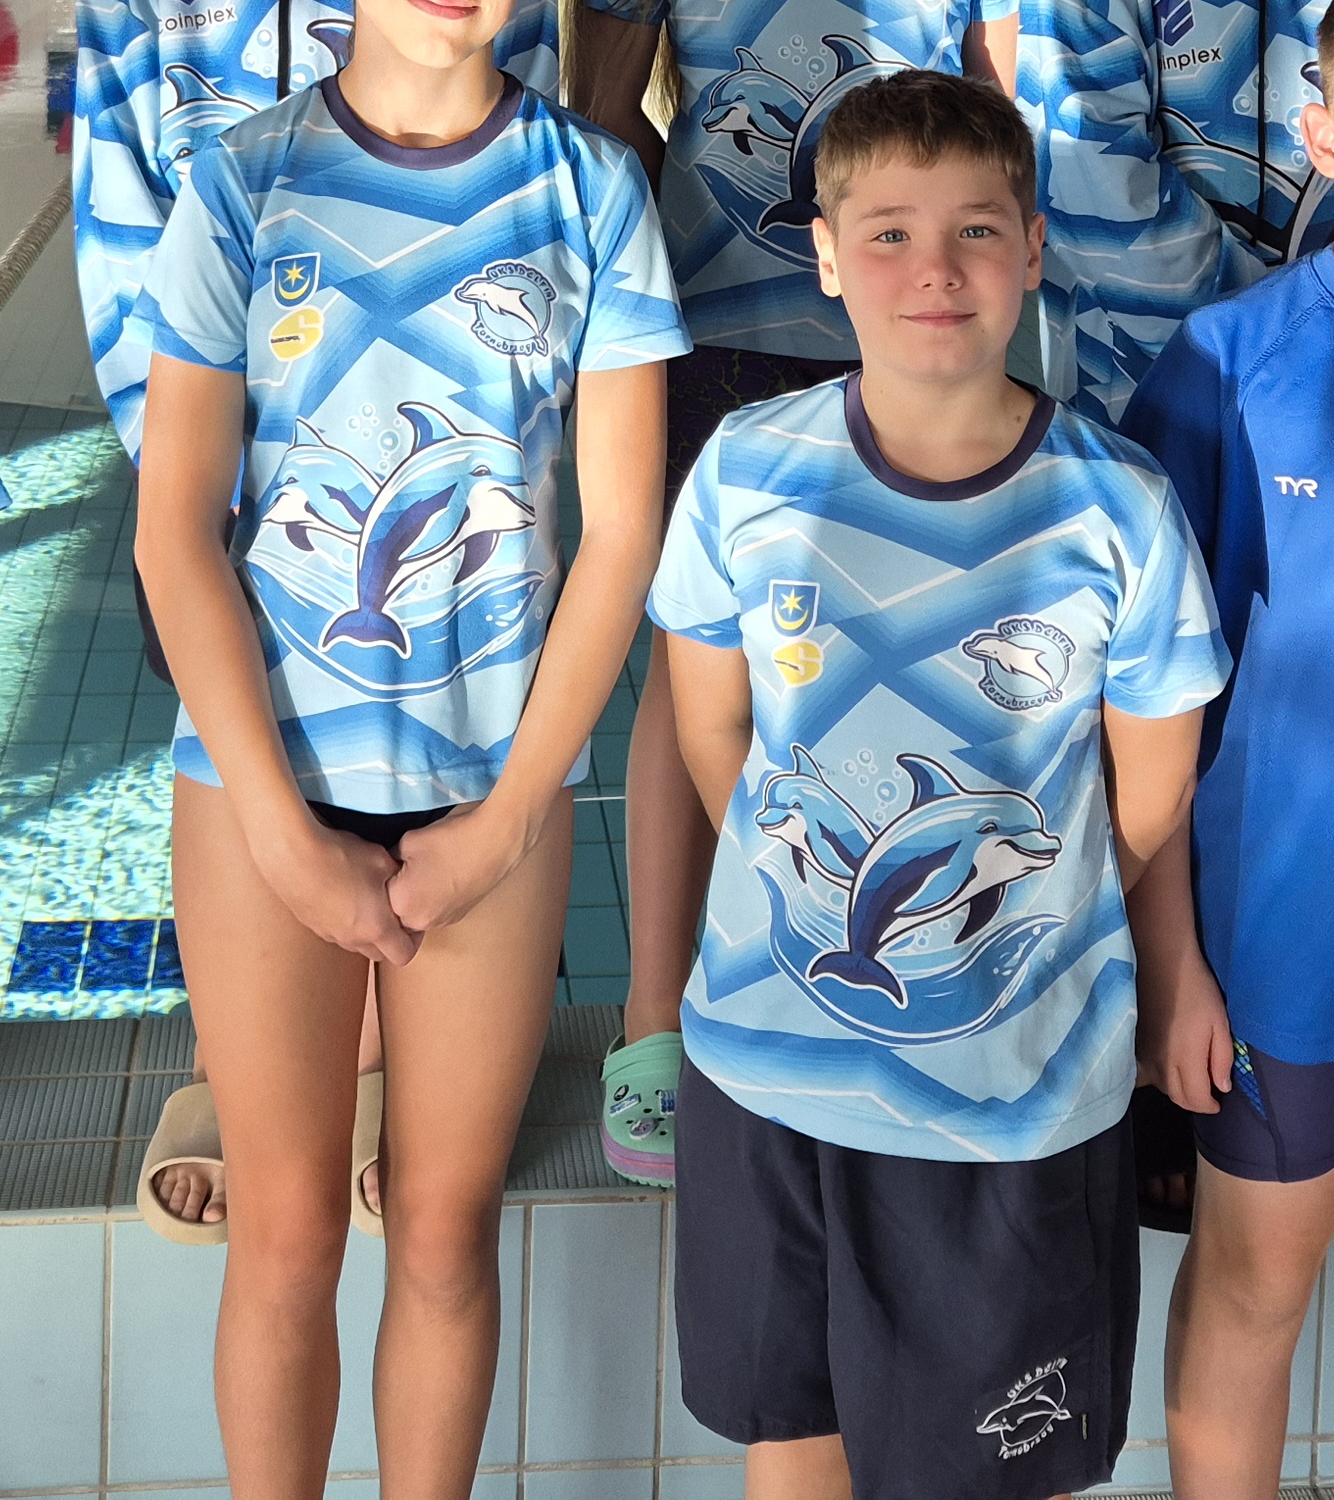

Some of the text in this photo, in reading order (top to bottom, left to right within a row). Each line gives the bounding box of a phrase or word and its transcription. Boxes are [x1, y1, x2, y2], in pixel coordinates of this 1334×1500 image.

[1158, 47, 1222, 71] inplex
[490, 267, 514, 279] UKS
[1274, 476, 1318, 498] TYR
[1002, 621, 1031, 636] UKS
